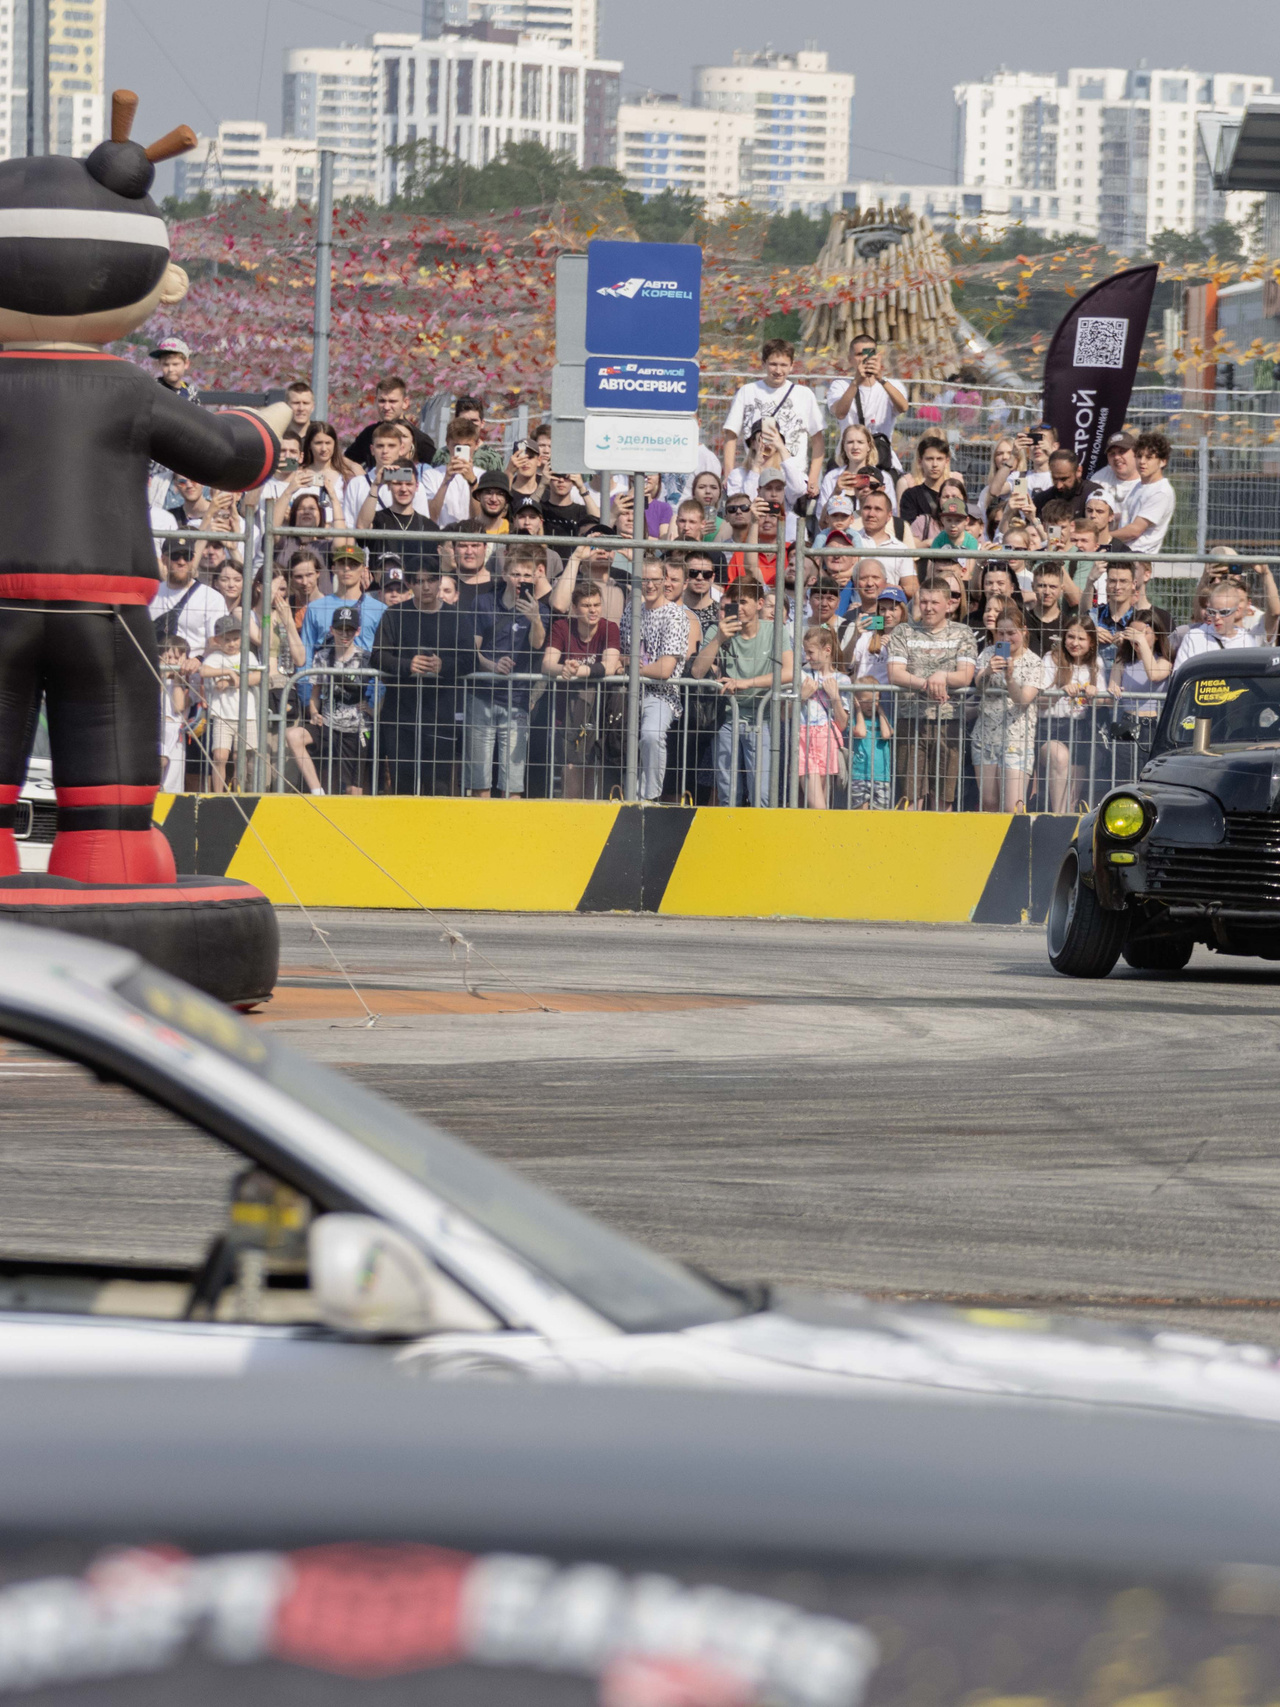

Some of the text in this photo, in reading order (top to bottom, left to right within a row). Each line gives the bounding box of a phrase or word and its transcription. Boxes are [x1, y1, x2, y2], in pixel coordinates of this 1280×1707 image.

[643, 280, 678, 290] АВТО
[641, 289, 693, 300] КОРЕЕЦ
[598, 378, 687, 393] АВТОСЕРВИС
[1092, 407, 1110, 455] КОМПАНИЯ
[616, 434, 689, 446] эдельвейс
[1200, 679, 1227, 687] MEGA
[1199, 686, 1231, 694] URBAN
